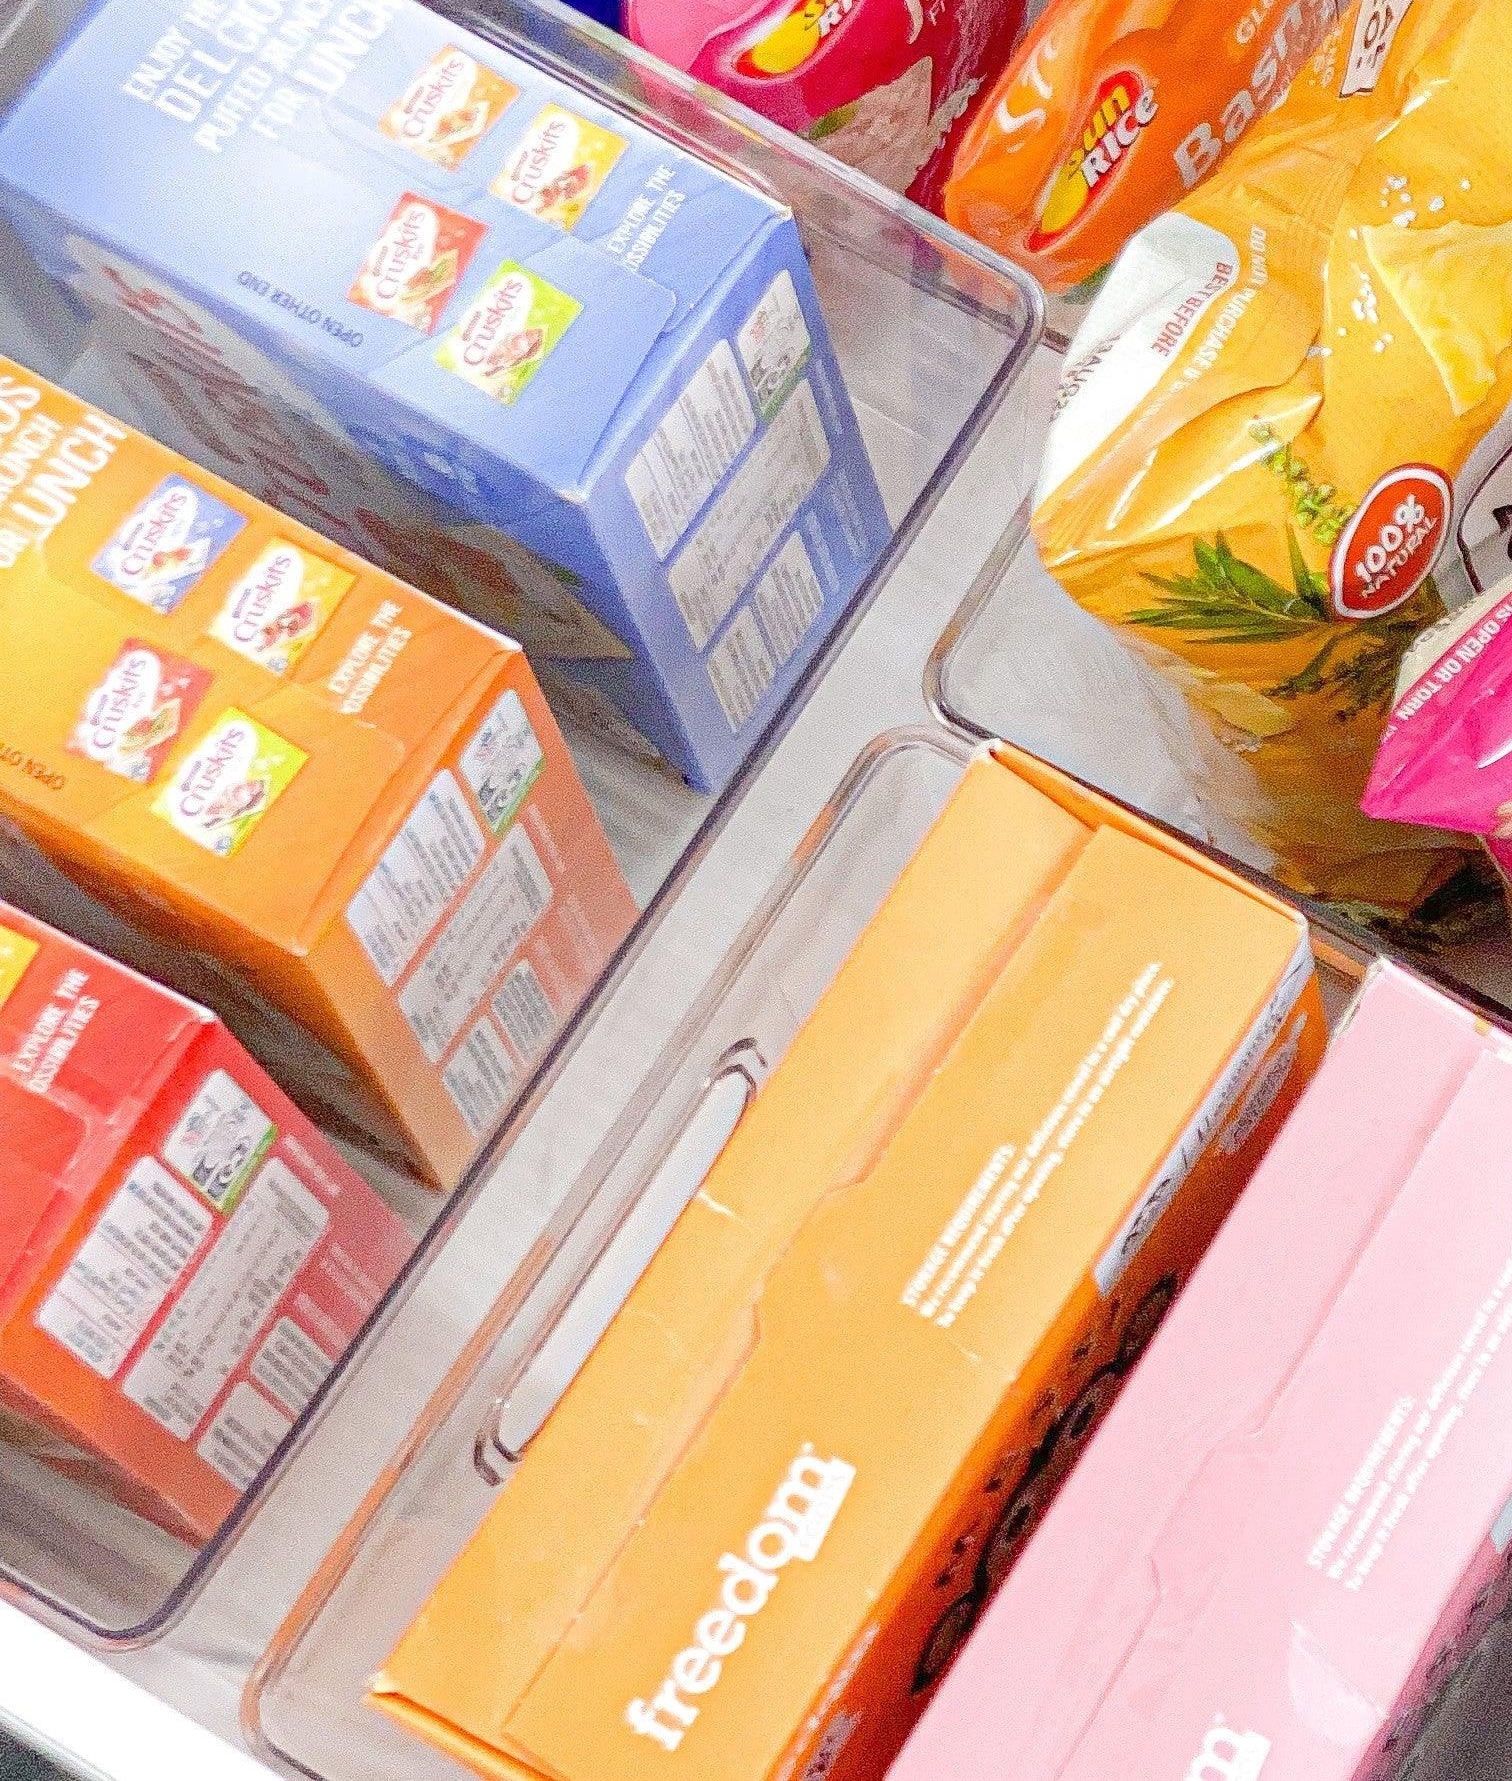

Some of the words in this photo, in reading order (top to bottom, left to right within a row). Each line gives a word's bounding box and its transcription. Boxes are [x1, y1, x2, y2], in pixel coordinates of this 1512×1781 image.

[122, 26, 194, 103] ENJOY
[405, 56, 468, 143] Cruskits
[255, 86, 306, 140] FOR
[513, 118, 567, 208] Cruskits
[237, 270, 274, 299] END
[378, 206, 429, 300] Cruskits
[1198, 262, 1235, 304] BEST
[271, 294, 321, 328] OTHER
[319, 315, 364, 347] OPEN
[464, 278, 523, 366] Cruskits
[1150, 302, 1200, 357] BEFORE
[1204, 284, 1255, 360] PURCHASE
[31, 413, 128, 541] LUNCH
[122, 485, 188, 579] Cruskits
[1351, 492, 1426, 584] 100%
[1356, 517, 1438, 599] NATURAL
[234, 550, 294, 644] Cruskits
[92, 654, 149, 750] Cruskits
[328, 638, 378, 697] EXPLORE
[1395, 674, 1445, 727] TORN
[1432, 655, 1464, 687] OR
[180, 725, 245, 821] Cruskits
[12, 1007, 63, 1072] EXPLORE
[896, 1242, 949, 1310] STORAGE
[938, 1136, 1018, 1246] REQUIREMENTS:
[625, 1454, 844, 1752] freedom
